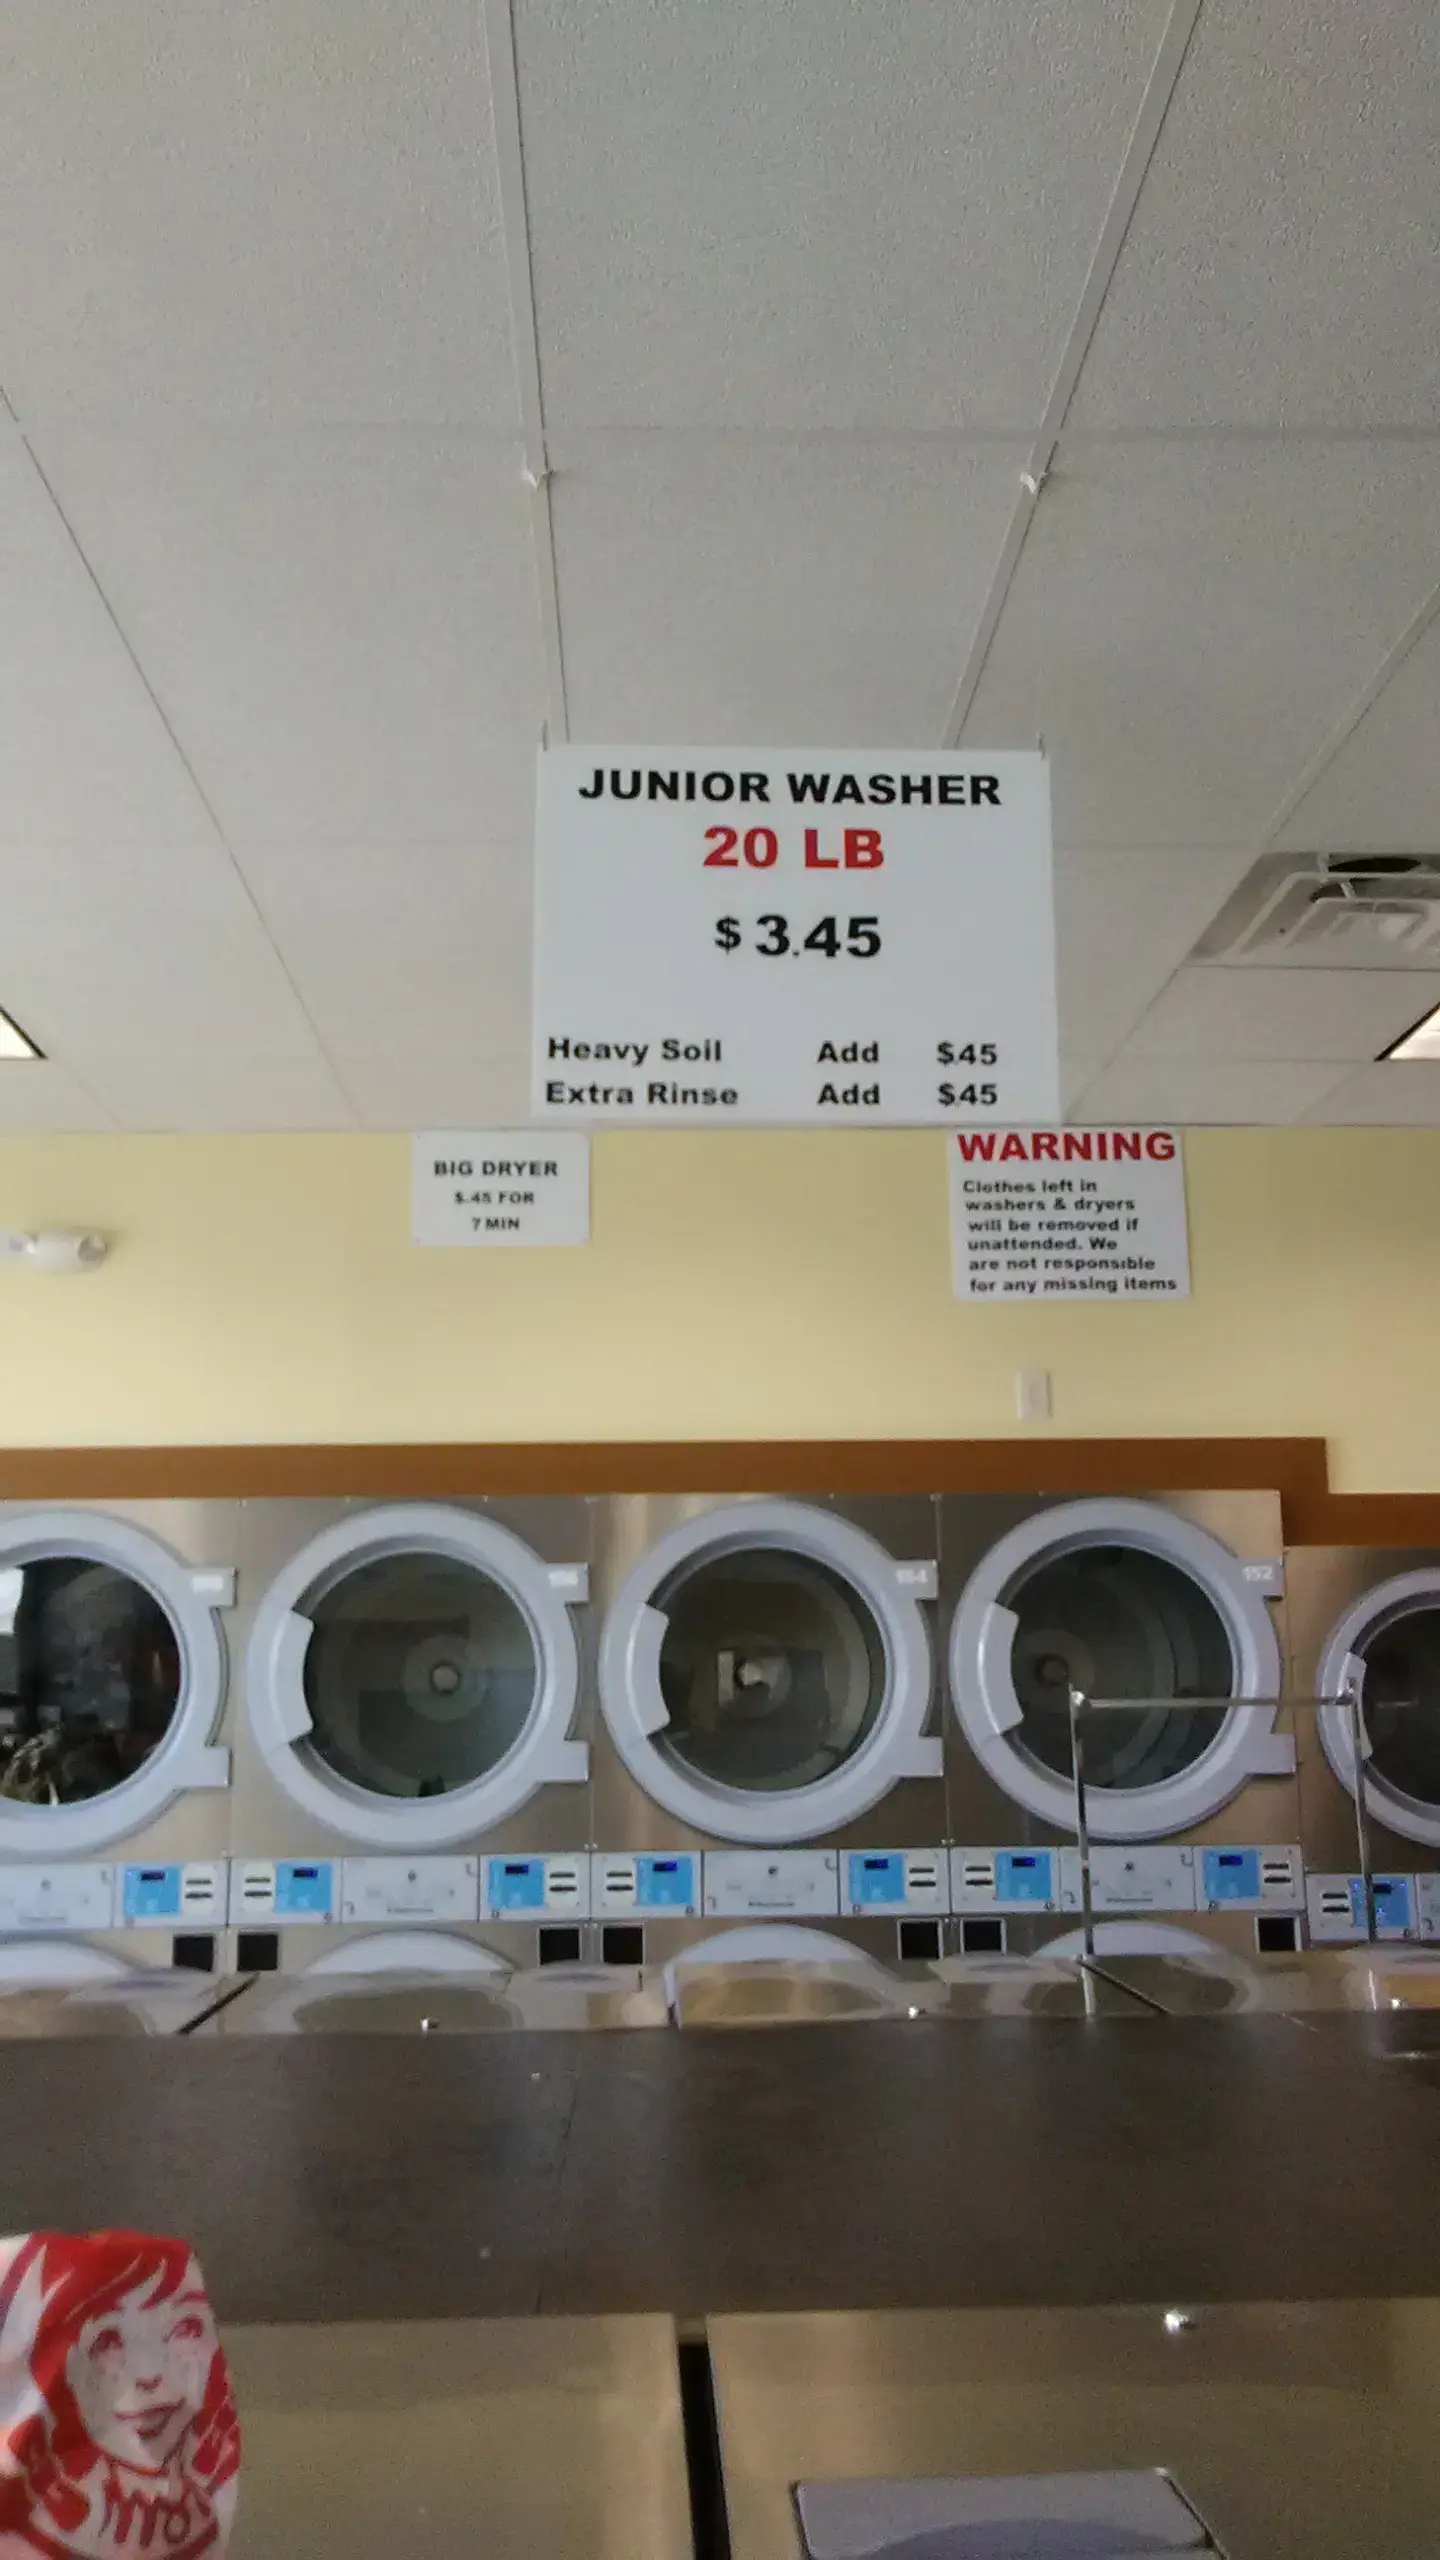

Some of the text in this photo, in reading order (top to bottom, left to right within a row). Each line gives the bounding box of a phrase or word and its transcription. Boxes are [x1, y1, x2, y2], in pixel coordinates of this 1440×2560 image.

[578, 769, 1003, 805] JUNIOR WASHER
[703, 827, 885, 869] 20 LB
[548, 1037, 649, 1067] Heavy
[661, 1039, 722, 1062] Soil
[817, 1041, 880, 1063] Add
[546, 1081, 634, 1105] Extra
[648, 1082, 739, 1105] Rinse
[817, 1083, 881, 1105] Add
[957, 1132, 1177, 1162] WARNING
[434, 1161, 558, 1177] BIG DRYER
[962, 1179, 1097, 1194] Clothes left in
[498, 1191, 535, 1205] FOR
[965, 1198, 1136, 1213] washers & dryers
[473, 1218, 520, 1231] 7 MIN
[968, 1218, 1140, 1232] will be removed if
[968, 1237, 1118, 1251] unattended. We
[969, 1257, 1156, 1272] are not responsible
[970, 1277, 1178, 1293] for any missing items
